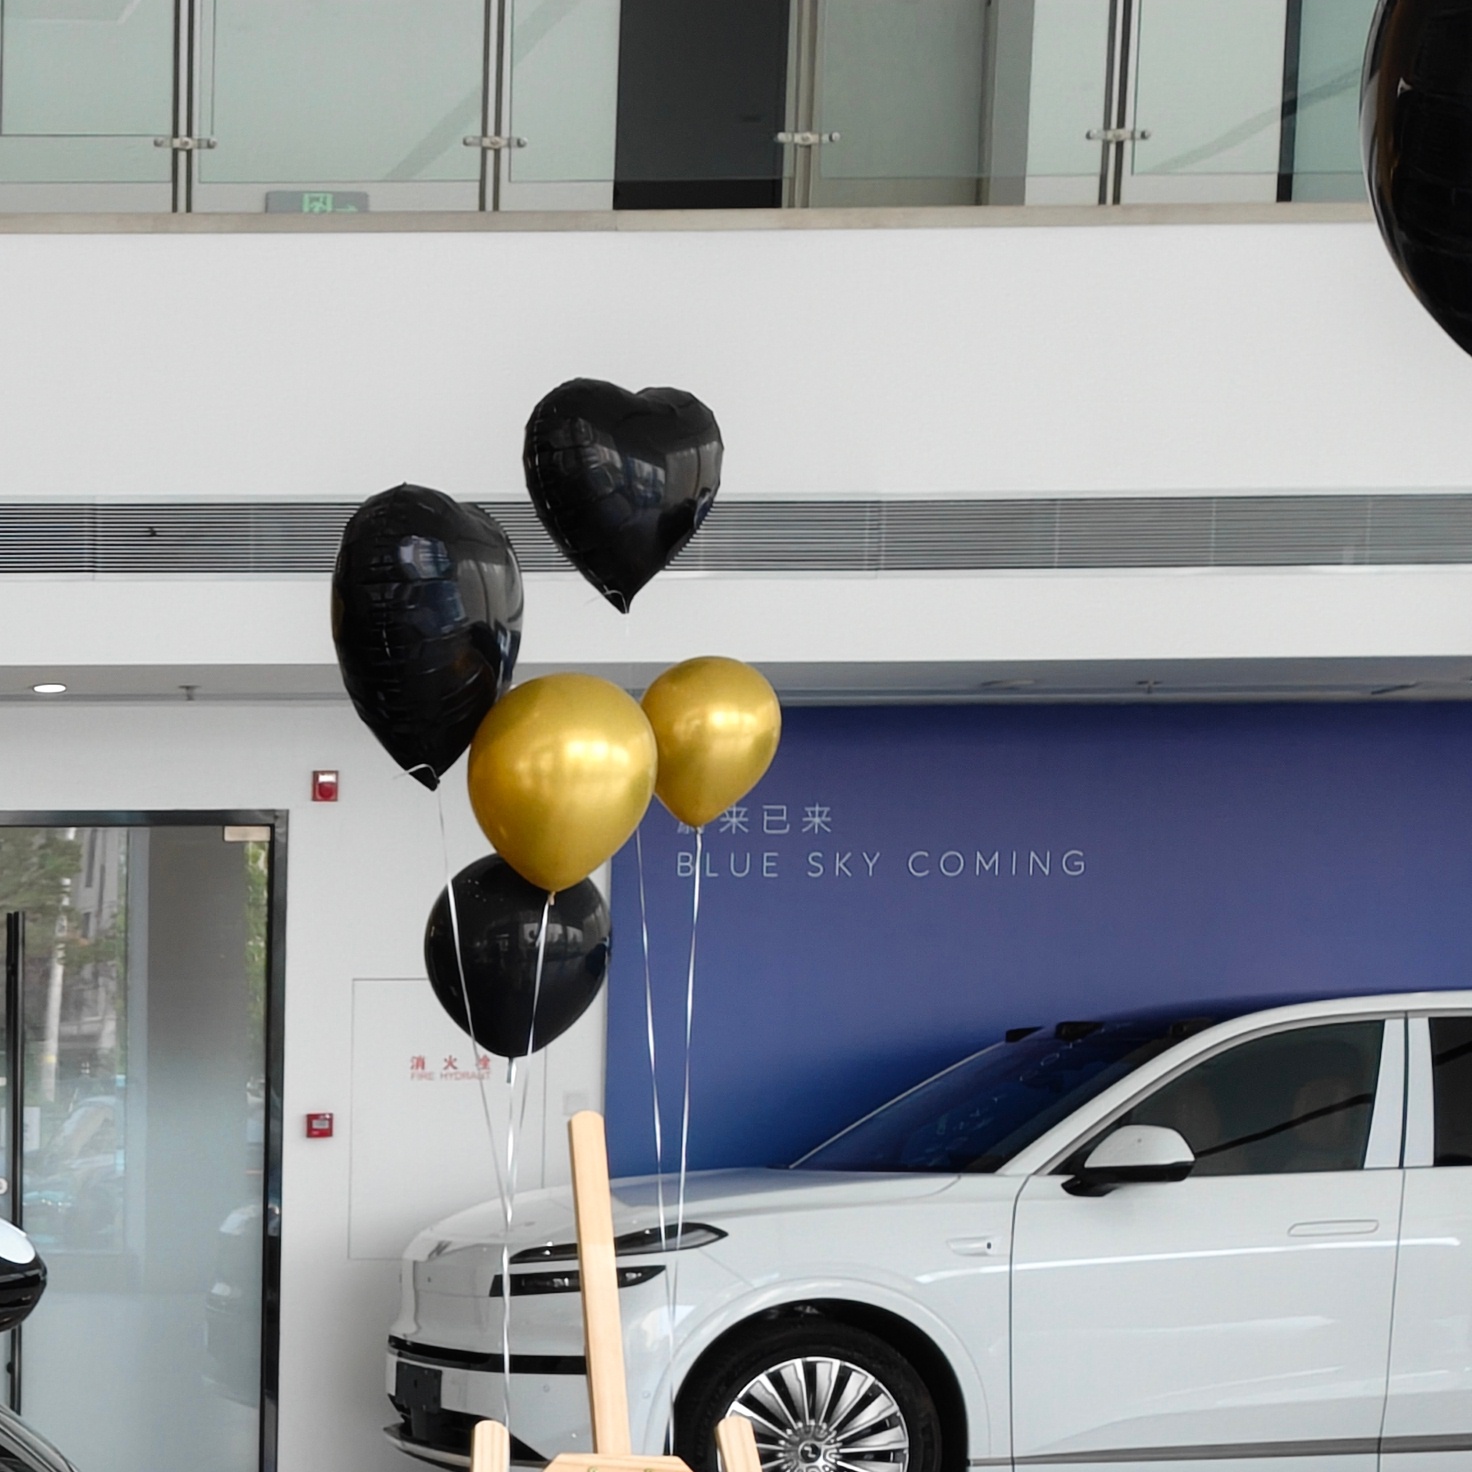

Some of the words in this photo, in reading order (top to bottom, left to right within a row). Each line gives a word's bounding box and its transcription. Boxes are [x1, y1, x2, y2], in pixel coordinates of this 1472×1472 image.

[676, 803, 832, 835] 来已来
[676, 851, 779, 878] BLUE
[806, 851, 881, 878] SKY
[908, 850, 1086, 878] COMING
